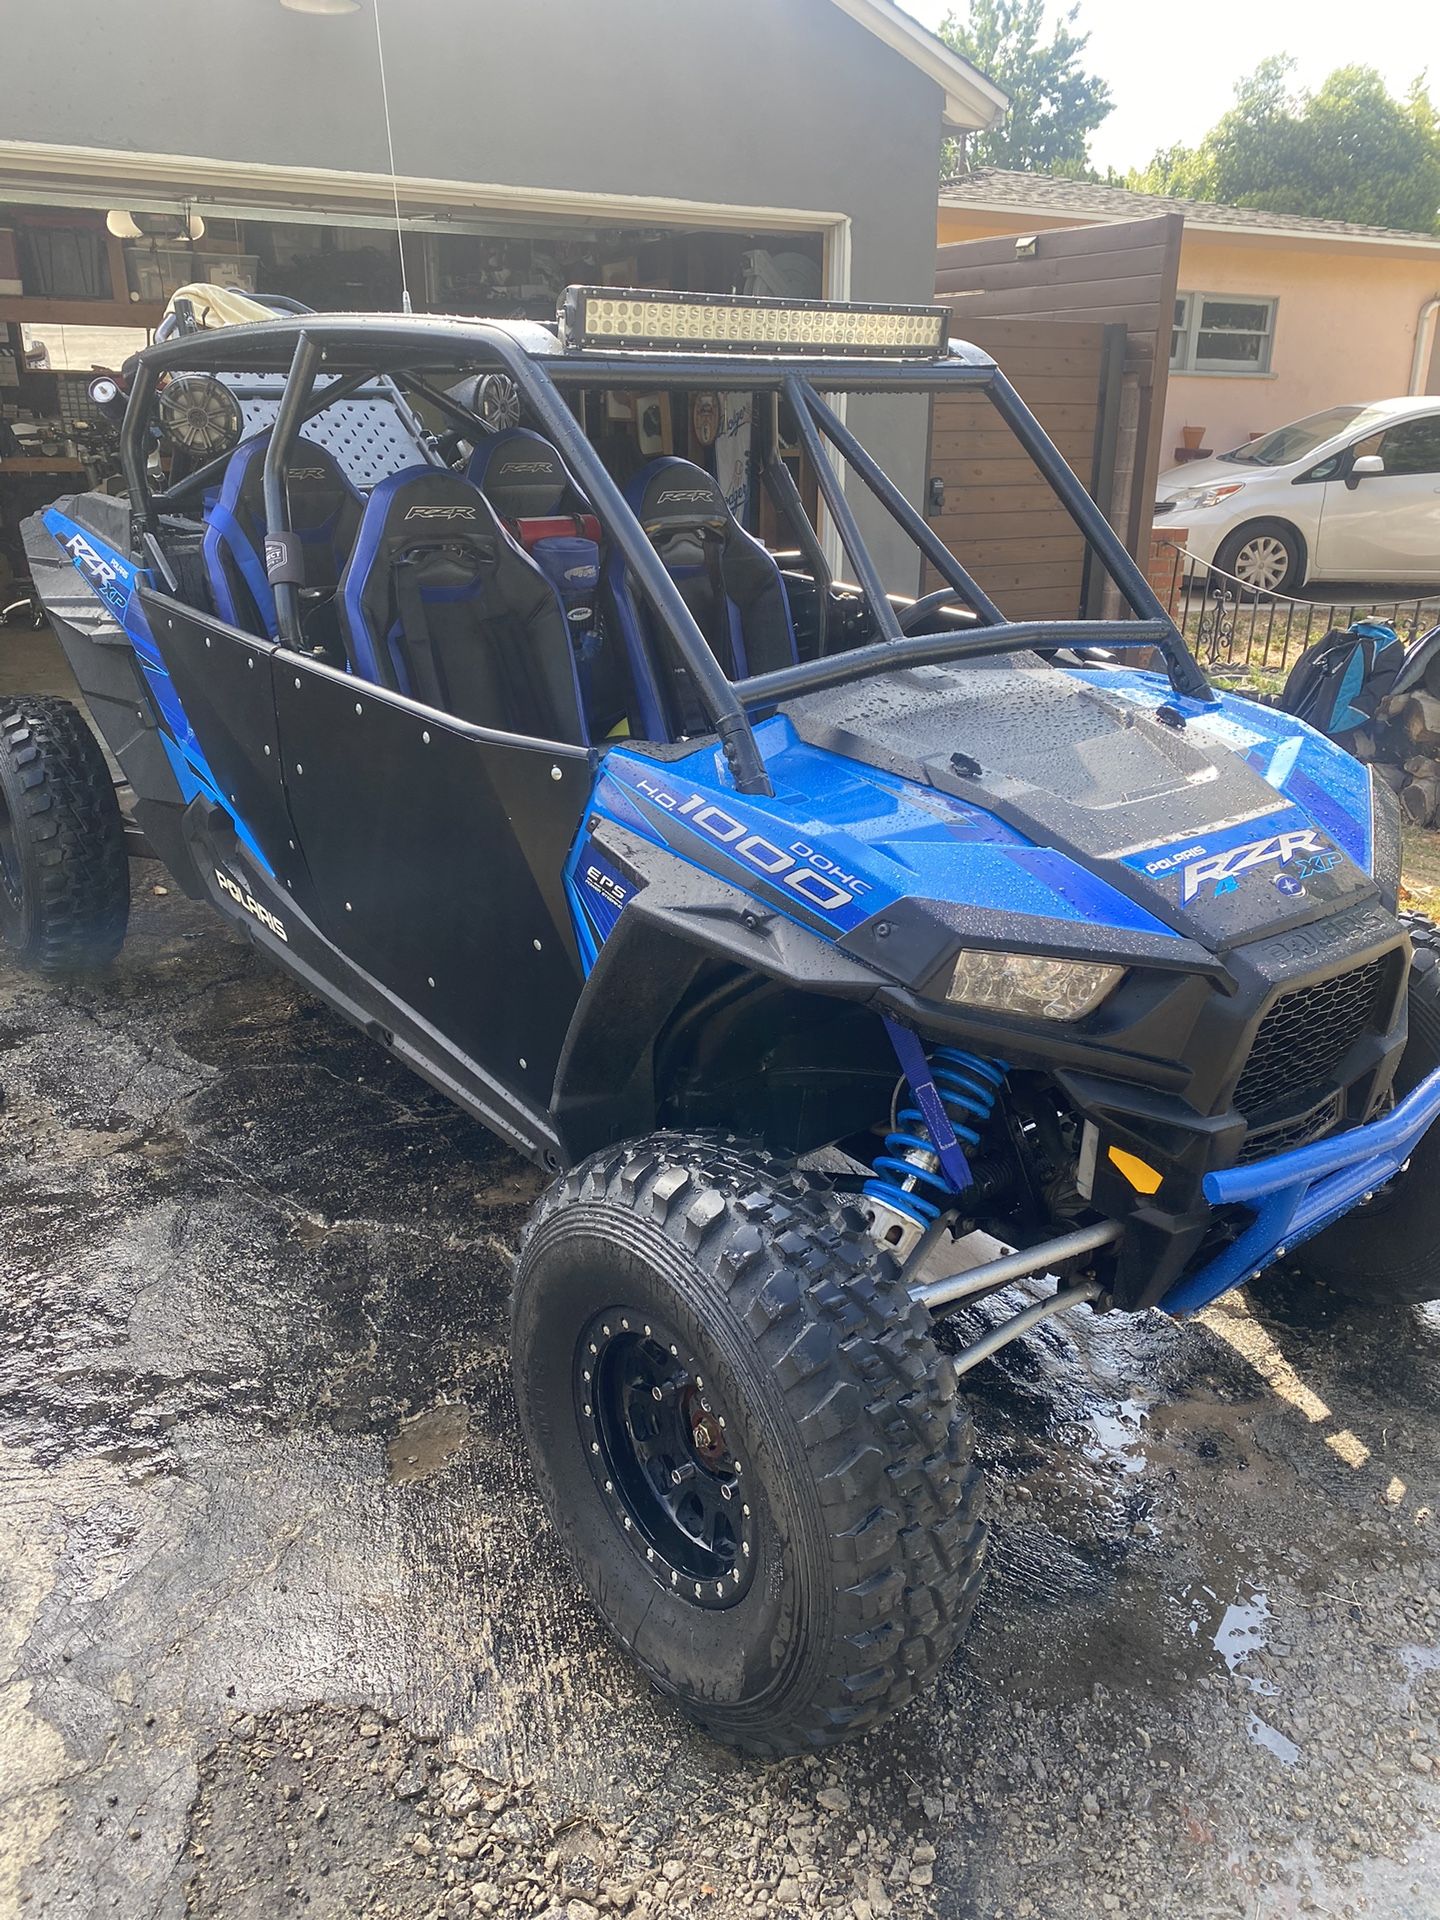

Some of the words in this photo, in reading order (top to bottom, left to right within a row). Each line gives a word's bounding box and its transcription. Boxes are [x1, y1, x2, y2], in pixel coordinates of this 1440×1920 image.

[500, 461, 553, 474] RZR
[657, 489, 714, 504] RZR
[404, 506, 476, 520] RZR
[65, 533, 117, 584] RZR
[110, 557, 129, 580] POLARIS
[99, 580, 128, 609] XP
[637, 780, 679, 812] H.O.
[677, 793, 853, 911] 1000
[1145, 845, 1207, 875] POLARIS
[789, 841, 873, 896] DOHC
[1182, 829, 1328, 907] RZR
[1294, 851, 1345, 880] XP
[586, 865, 627, 899] EPS
[1213, 874, 1242, 898] 4
[214, 867, 288, 943] POLARIS
